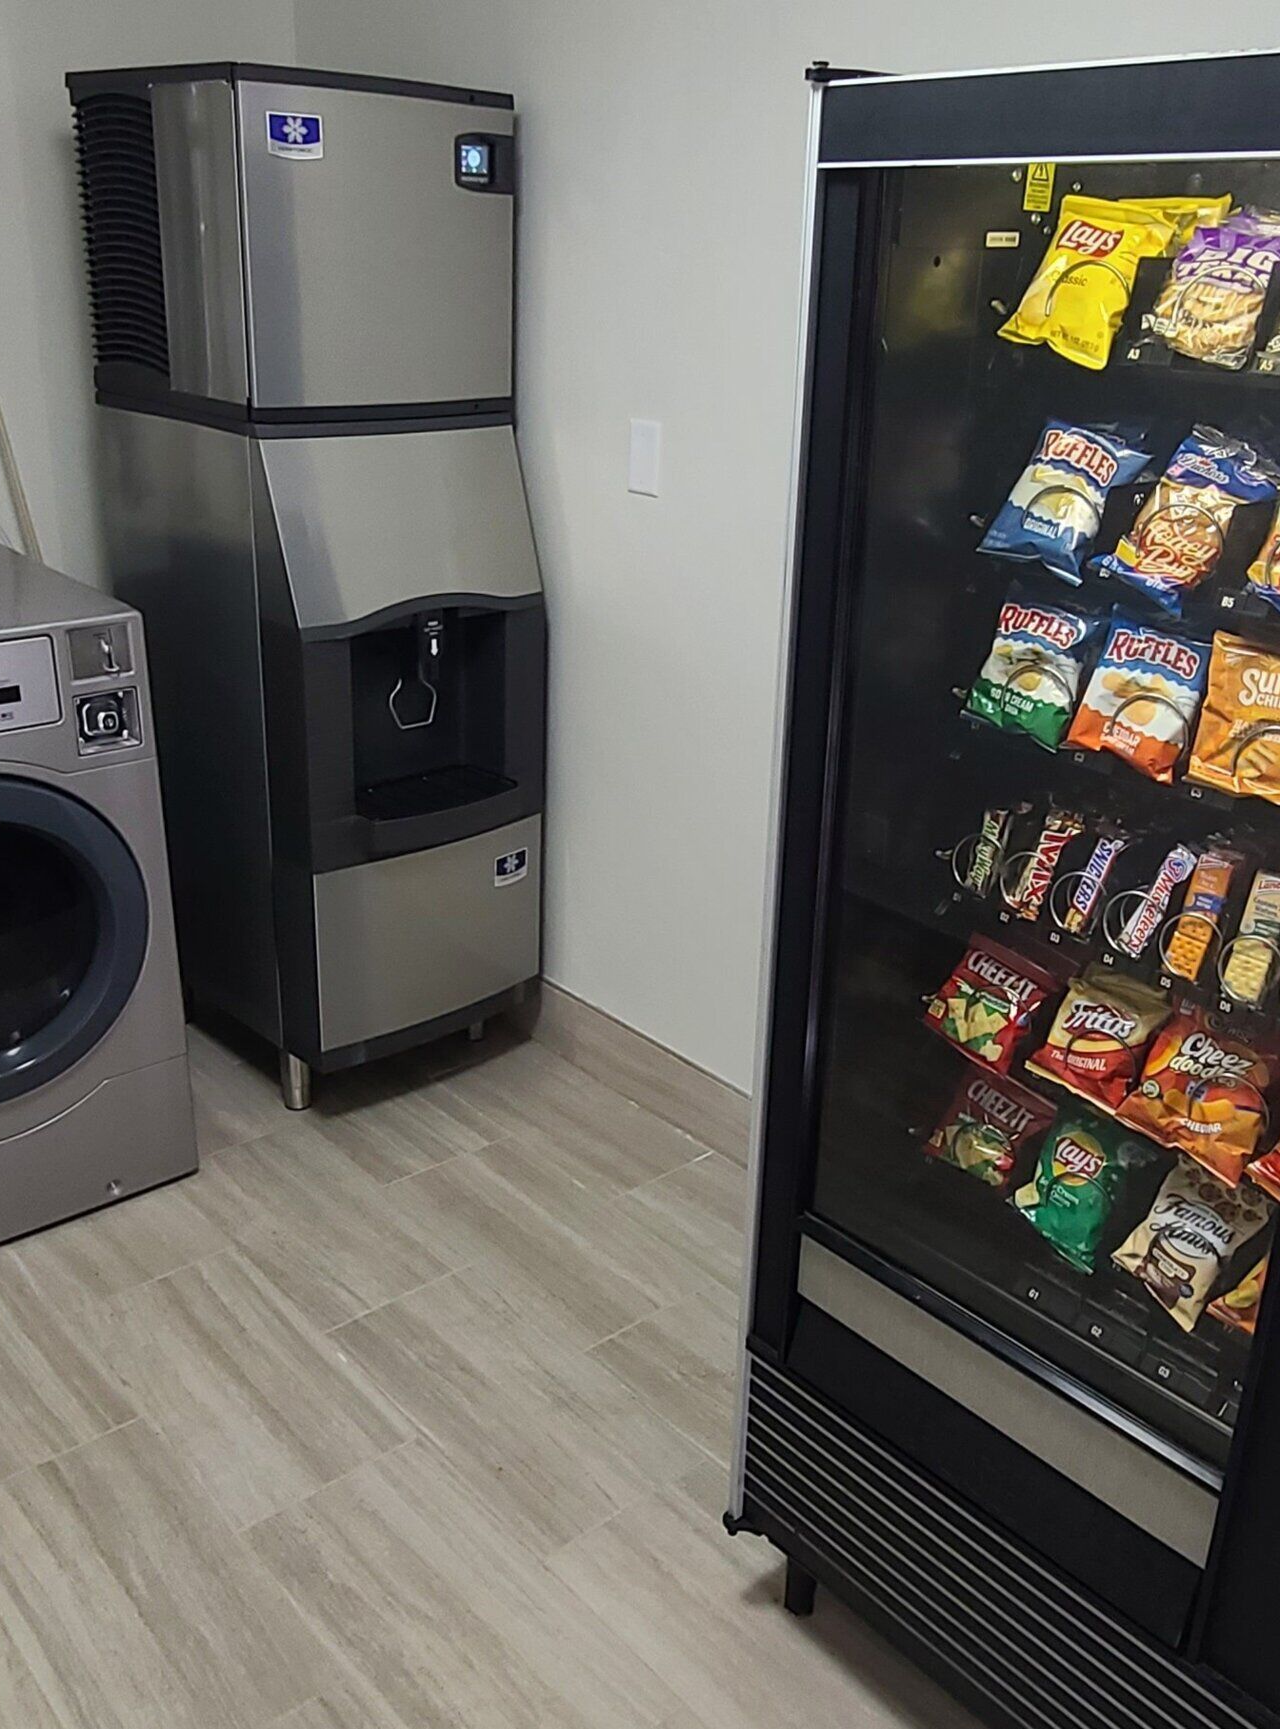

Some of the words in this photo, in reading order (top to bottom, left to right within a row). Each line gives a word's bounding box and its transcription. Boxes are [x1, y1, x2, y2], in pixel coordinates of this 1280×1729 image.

[1058, 220, 1121, 256] Lay's
[1222, 596, 1235, 608] B5
[1000, 604, 1076, 648] RUFFLES
[1107, 630, 1199, 679] RUFFLES
[1024, 827, 1081, 904] TWIX
[1062, 1000, 1137, 1038] Fritos
[1181, 1032, 1254, 1076] Cheez
[1153, 1193, 1236, 1245] Famous
